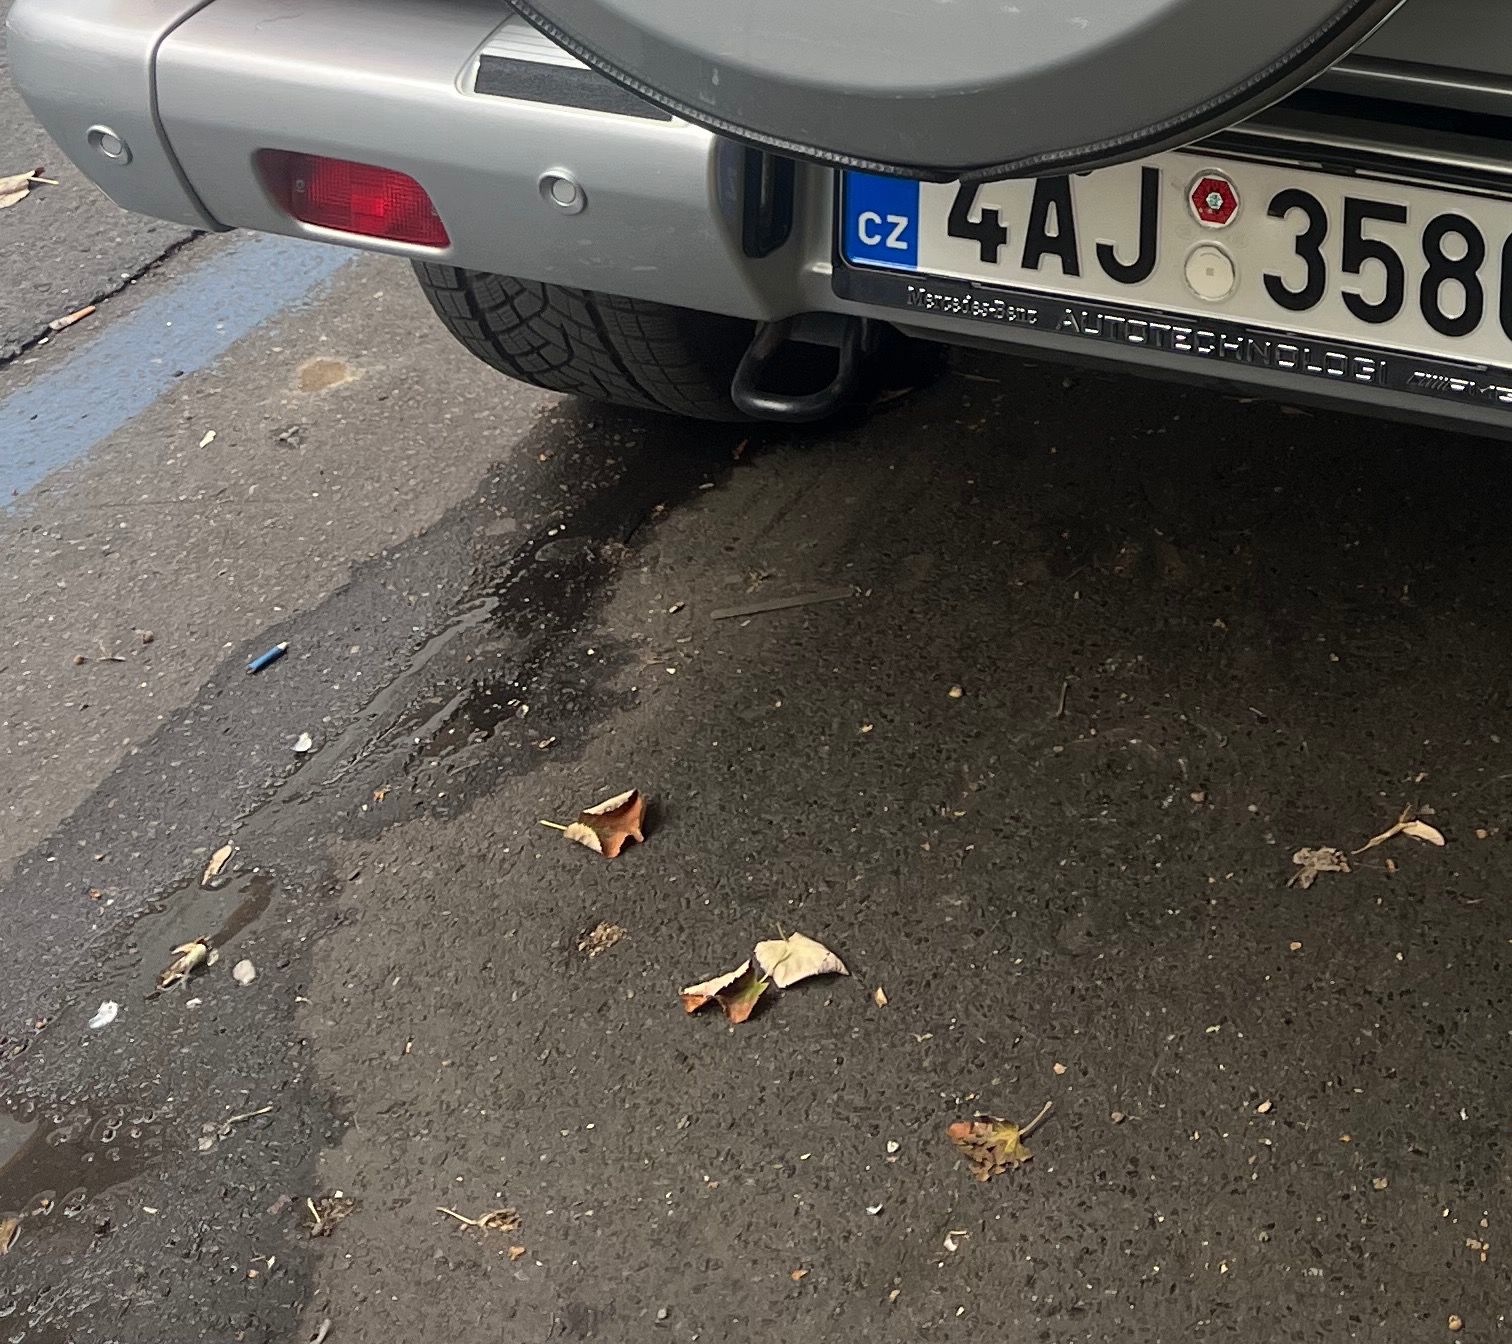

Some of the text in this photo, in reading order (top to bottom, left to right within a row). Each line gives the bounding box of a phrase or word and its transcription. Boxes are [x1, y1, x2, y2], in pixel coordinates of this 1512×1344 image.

[857, 211, 909, 250] CZ
[947, 166, 1159, 285] 4AJ
[905, 285, 1039, 325] Mercedes-Benz
